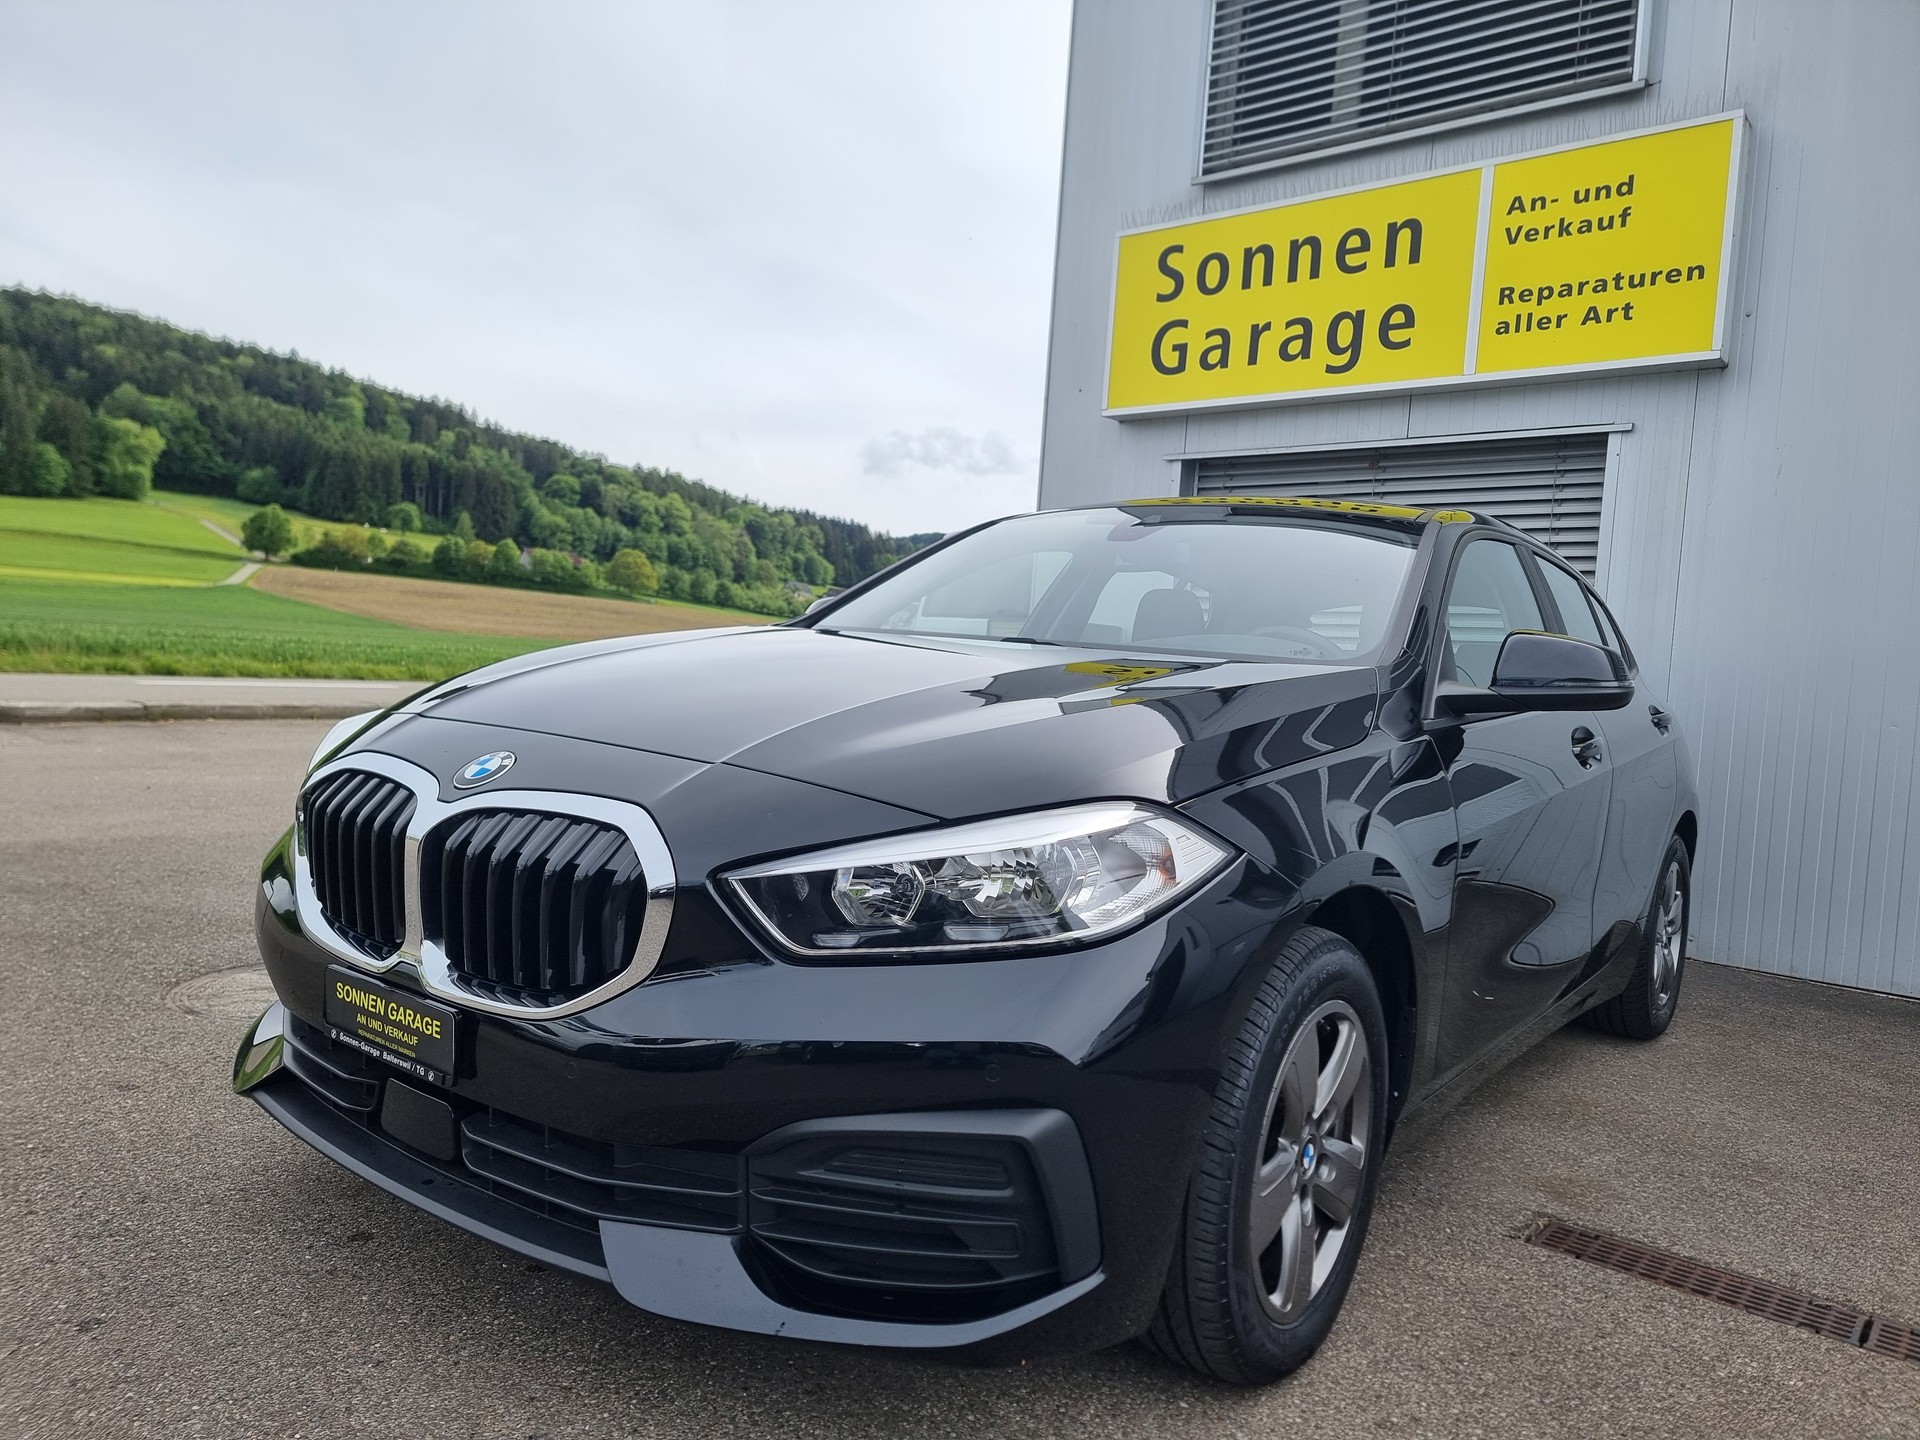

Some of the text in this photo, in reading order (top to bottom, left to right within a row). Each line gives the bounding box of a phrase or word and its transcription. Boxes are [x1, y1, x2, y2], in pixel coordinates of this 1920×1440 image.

[1506, 174, 1635, 216] An- und
[1504, 205, 1632, 245] Verkauf
[1155, 216, 1423, 303] Sonnen
[1498, 264, 1705, 307] Reparaturen
[1150, 302, 1416, 376] Garage
[1495, 301, 1635, 336] aller Art
[336, 982, 441, 1039] SONNEN GARAGE
[356, 1013, 419, 1047] AN UND VERKAUF
[339, 1032, 380, 1057] Sonnen-Garage
[382, 1051, 412, 1070] Balterswil
[416, 1065, 425, 1076] TG
